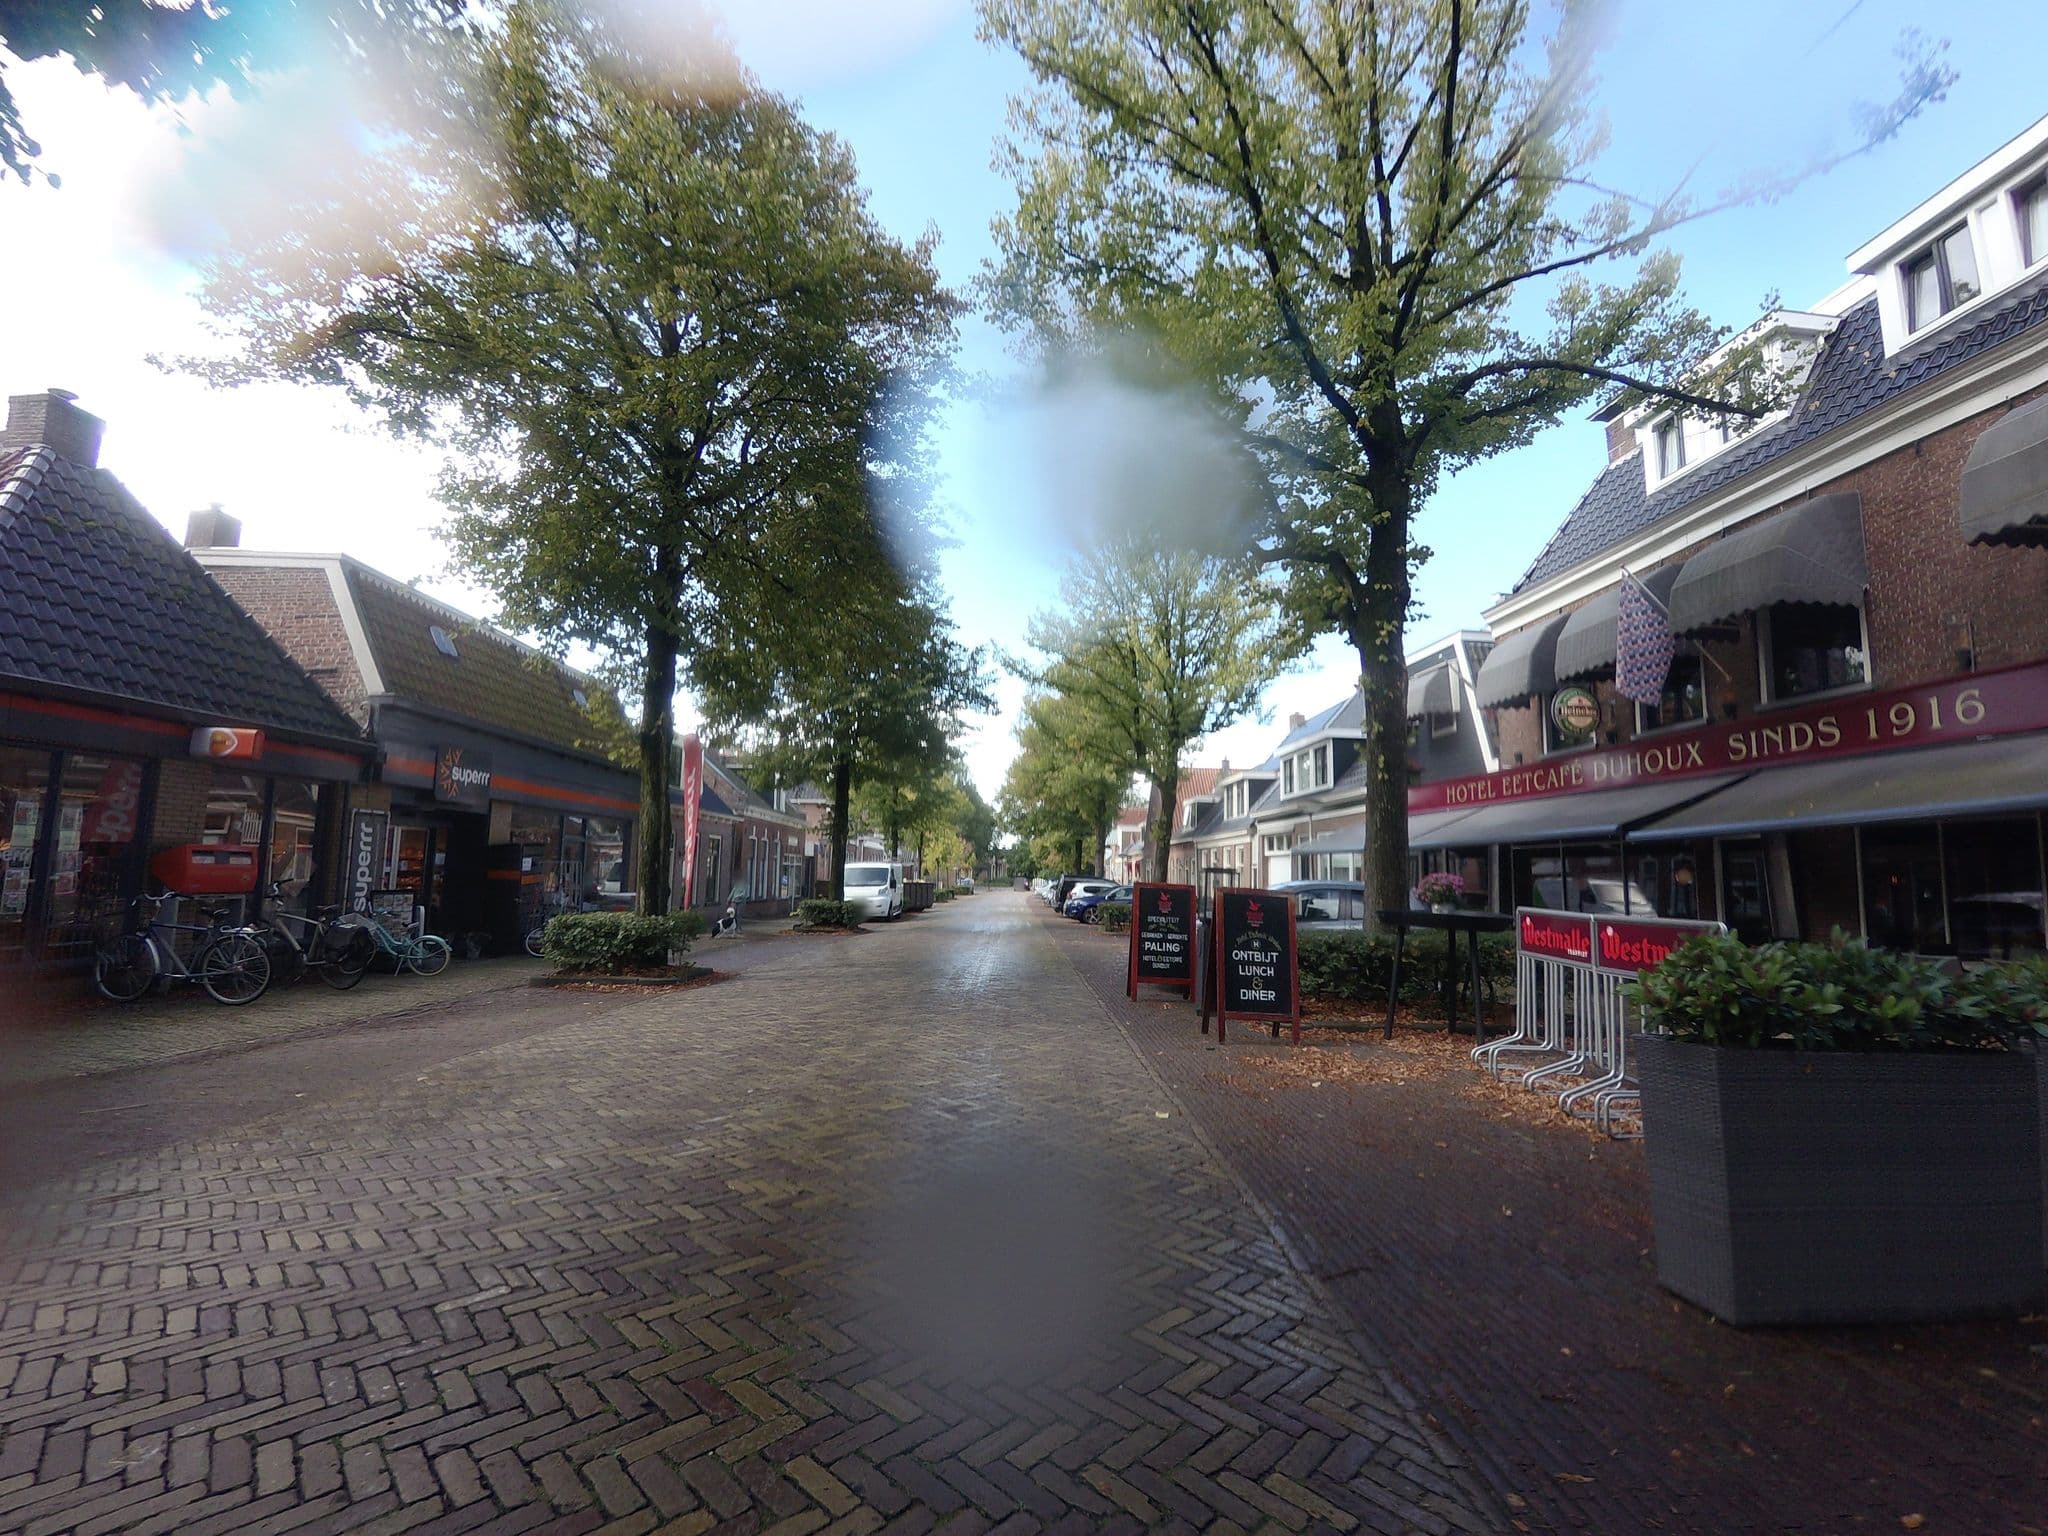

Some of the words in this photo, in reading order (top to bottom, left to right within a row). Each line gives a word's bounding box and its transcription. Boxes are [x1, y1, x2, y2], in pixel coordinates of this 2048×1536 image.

[1447, 779, 1496, 804] HOTEL
[1502, 760, 1583, 797] EETCAFÉ
[1593, 741, 1704, 783] DUHOUX
[1728, 716, 1841, 761] SINDS
[1866, 688, 1986, 739] 1916
[452, 766, 490, 787] superrr
[353, 822, 374, 912] superrr
[1522, 916, 1590, 951] Westmalle
[1144, 941, 1181, 953] PALING
[1600, 928, 1672, 964] Westm
[1232, 949, 1279, 963] ONTBIJT
[1239, 964, 1275, 977] LUNCH
[1252, 976, 1263, 990] &
[1240, 988, 1276, 1001] DINER
